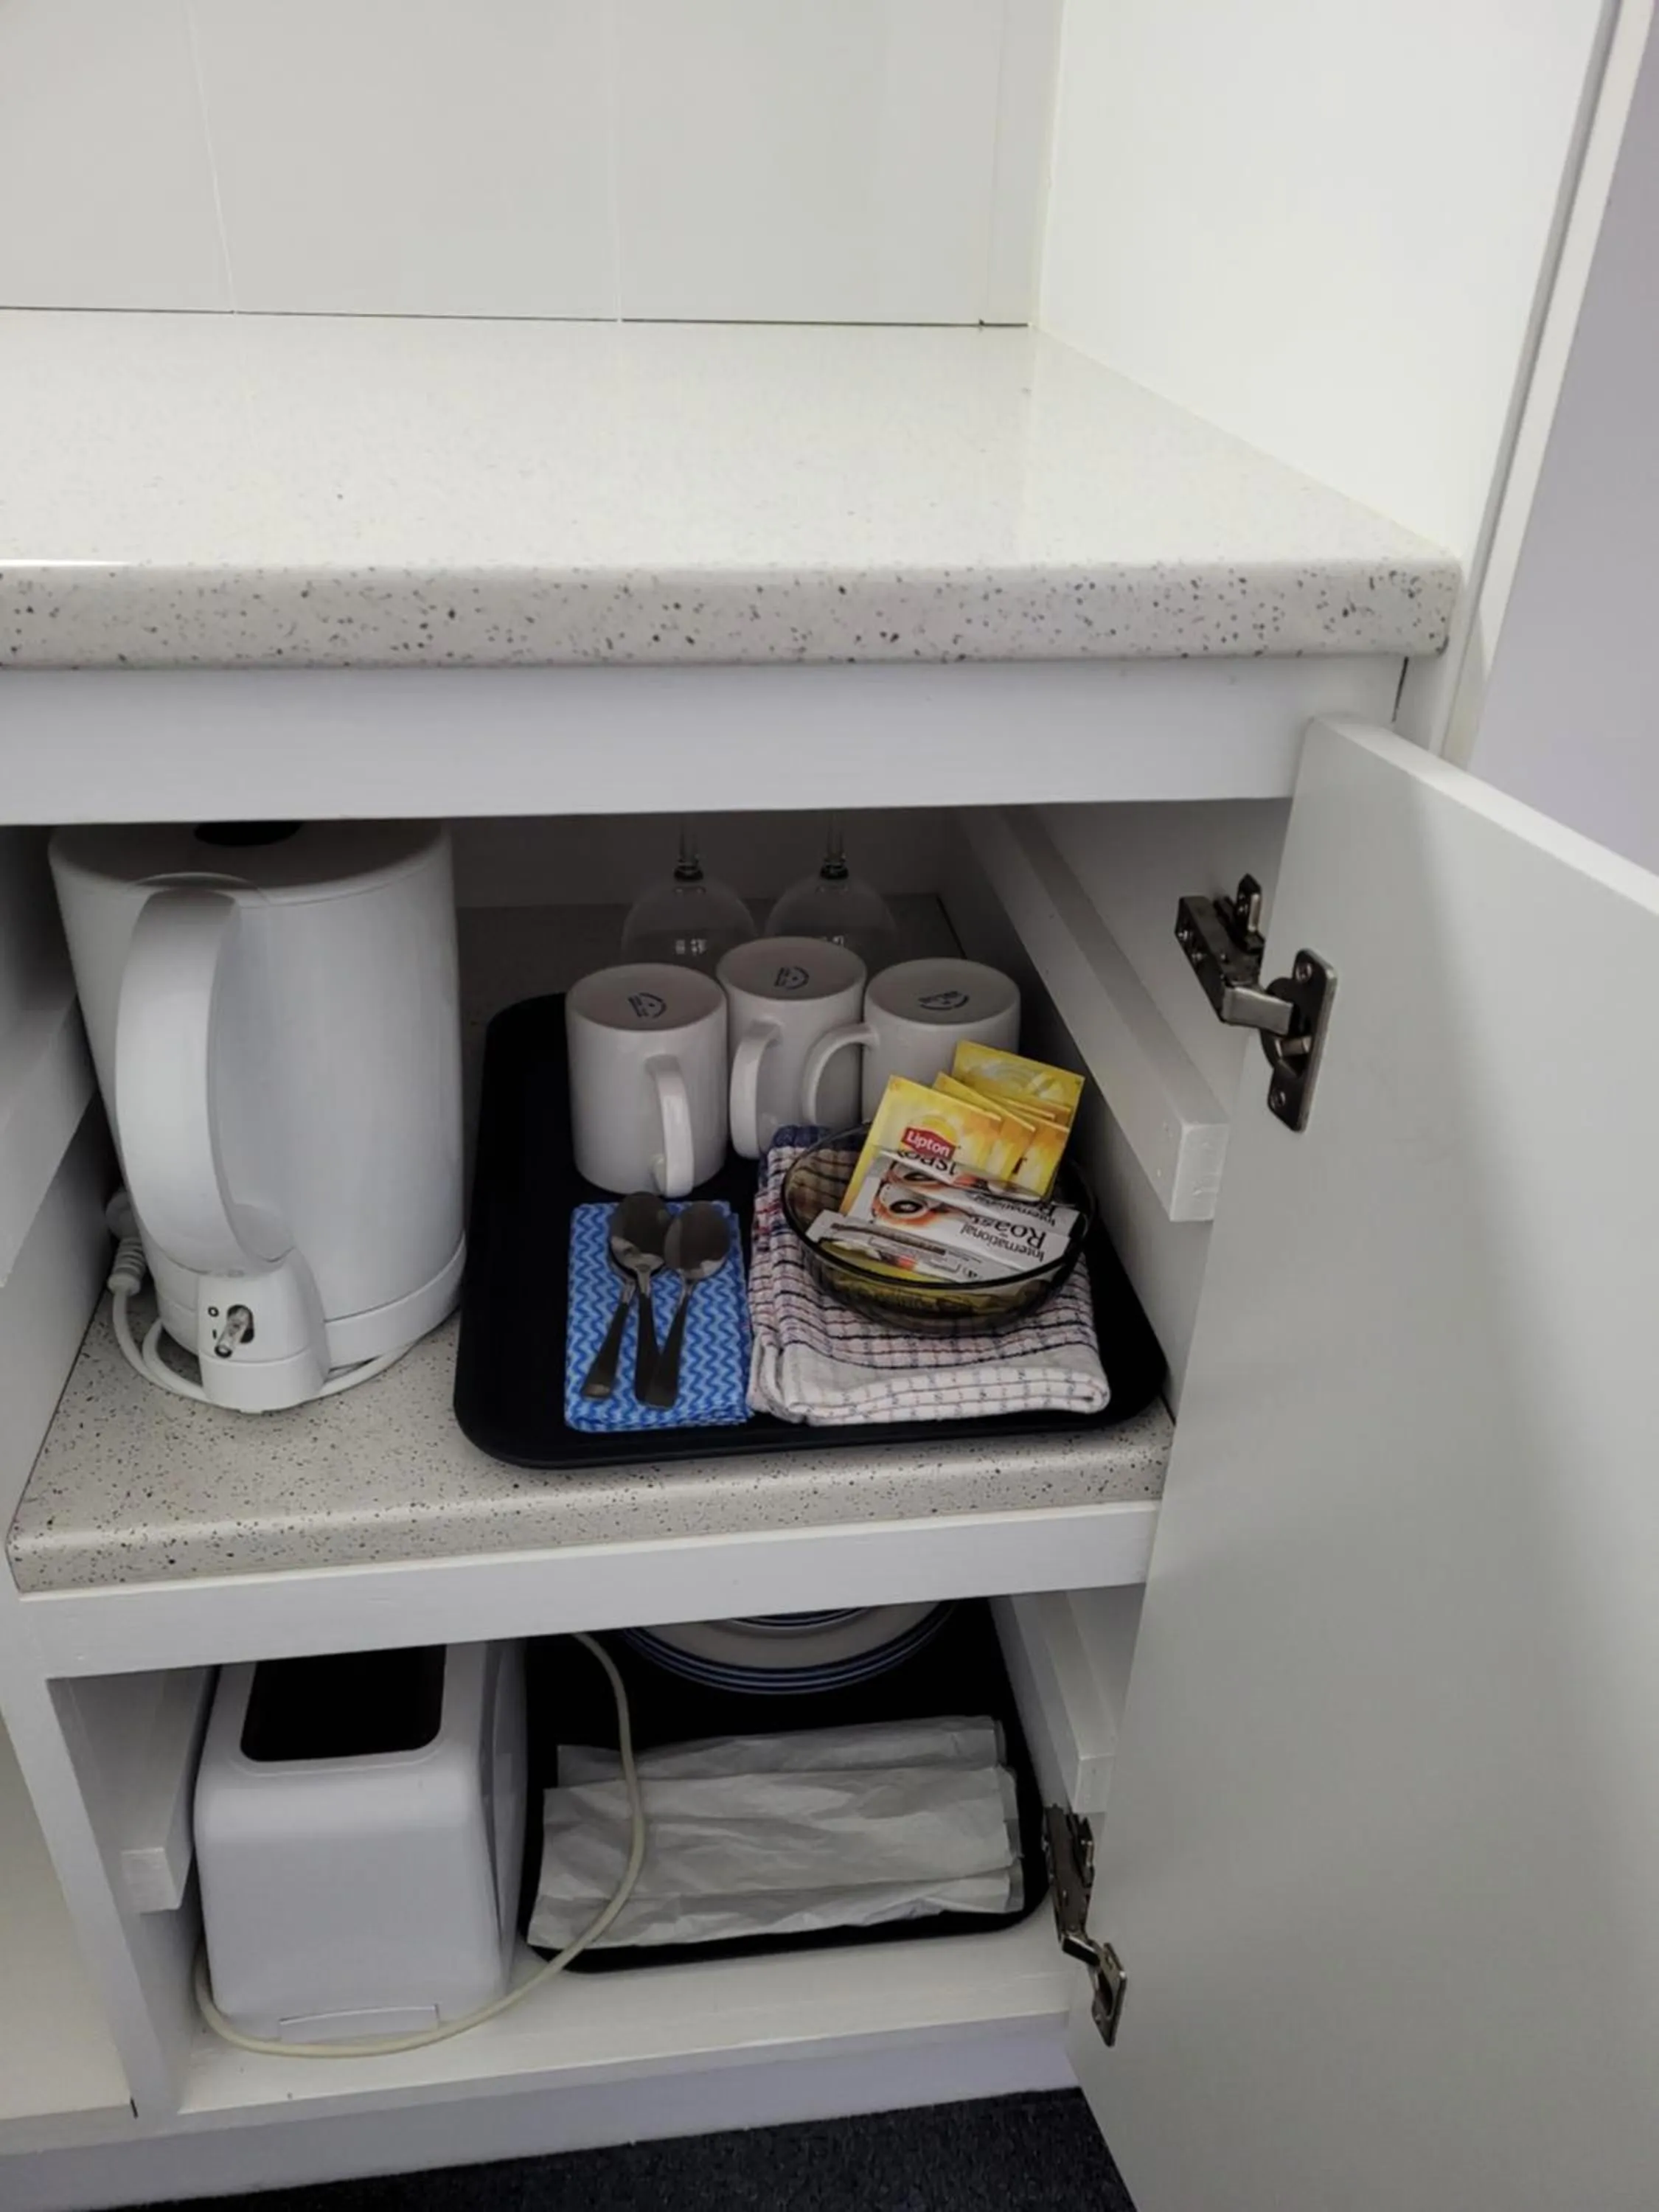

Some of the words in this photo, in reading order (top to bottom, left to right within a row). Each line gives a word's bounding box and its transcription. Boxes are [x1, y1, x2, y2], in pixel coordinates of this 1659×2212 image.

[905, 1130, 951, 1158] Lipton
[959, 1223, 1045, 1262] International
[970, 1215, 1047, 1250] Roast
